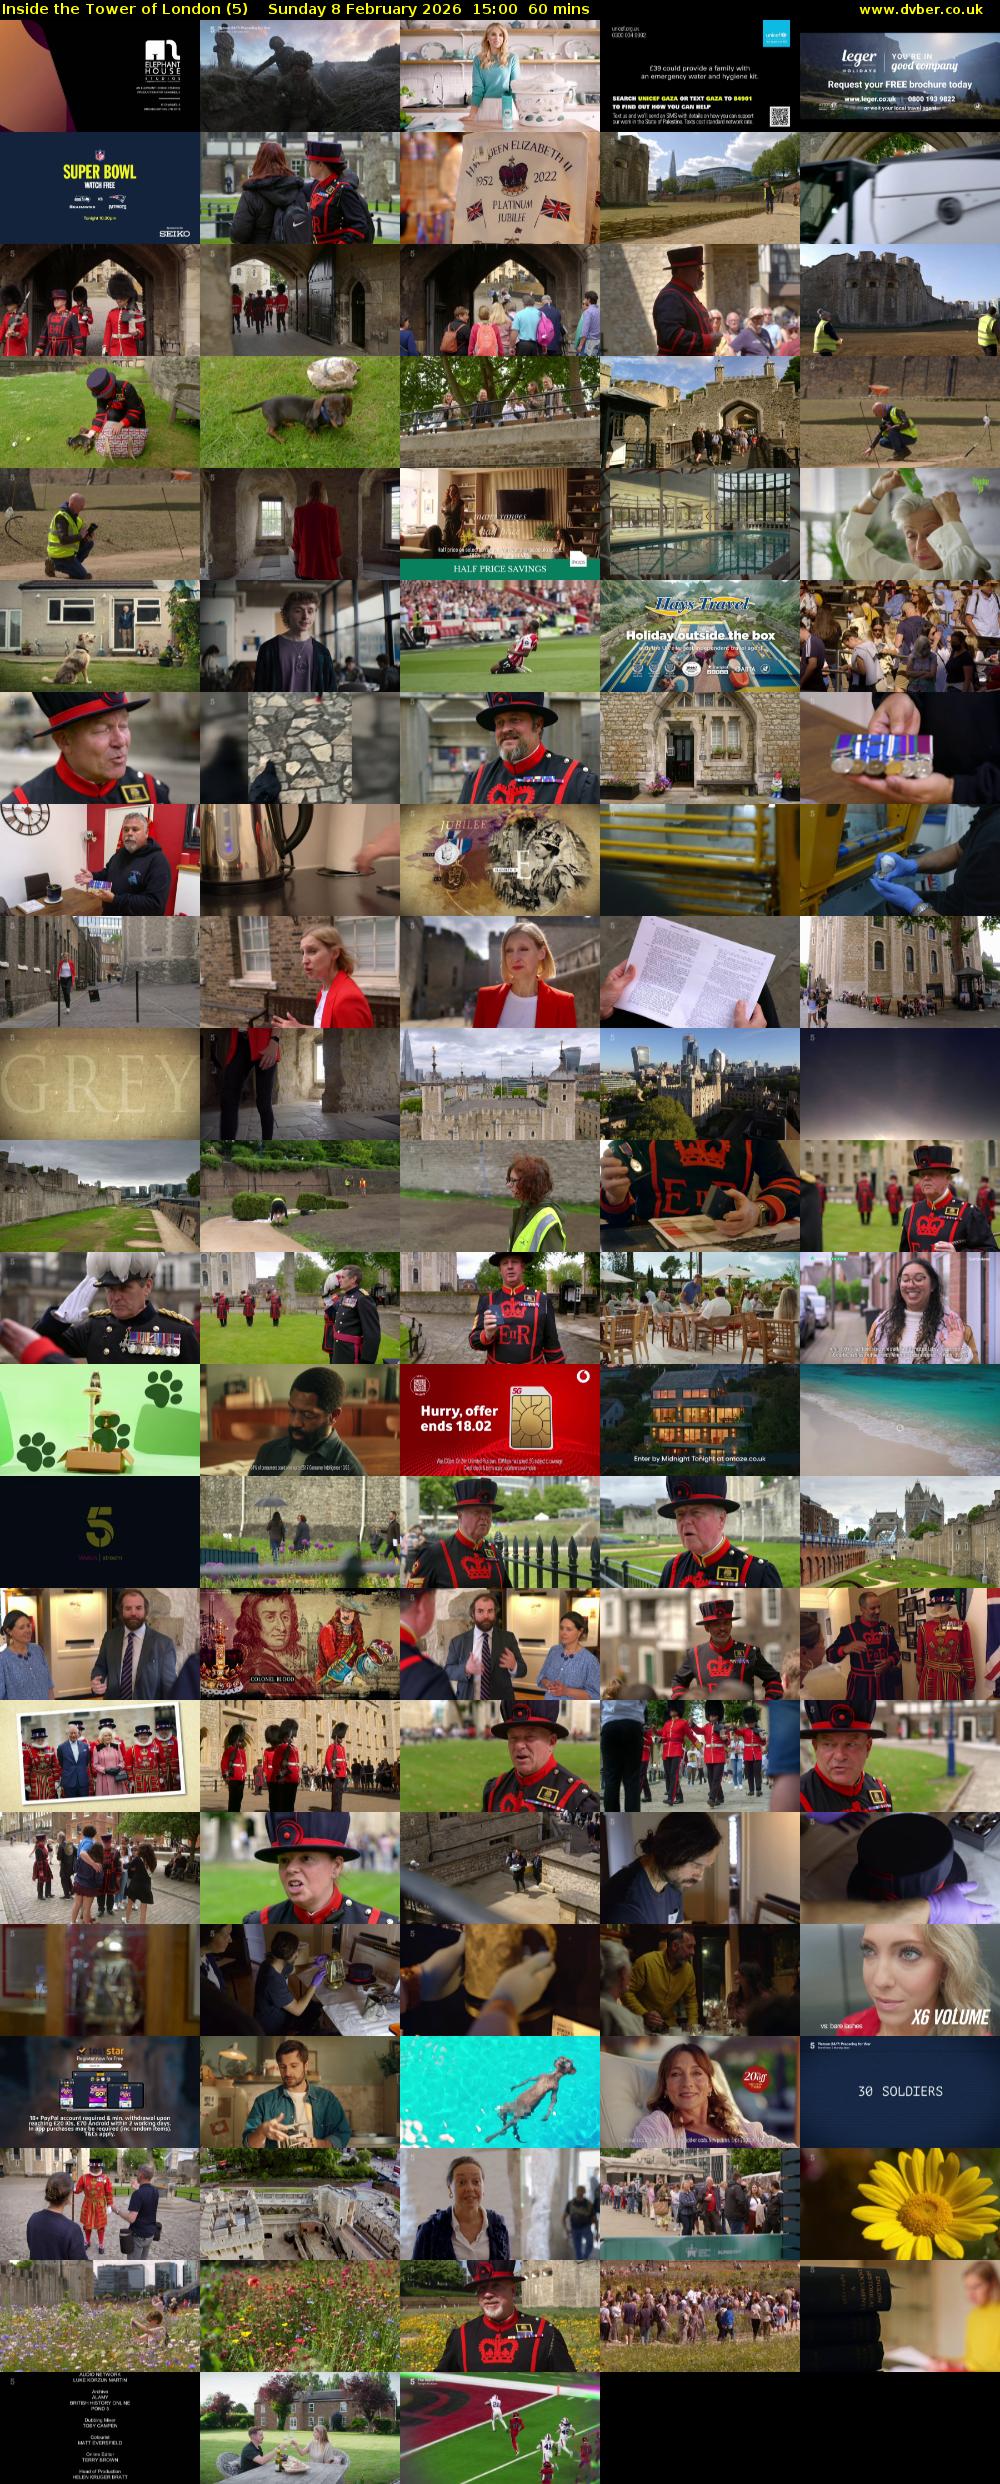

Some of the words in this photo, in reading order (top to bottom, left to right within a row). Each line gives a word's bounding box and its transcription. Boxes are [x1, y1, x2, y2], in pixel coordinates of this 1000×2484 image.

[476, 176, 494, 186] 1952
[534, 171, 556, 183] 2022
[492, 200, 533, 210] PLATINUM
[498, 213, 526, 222] JUBILEE
